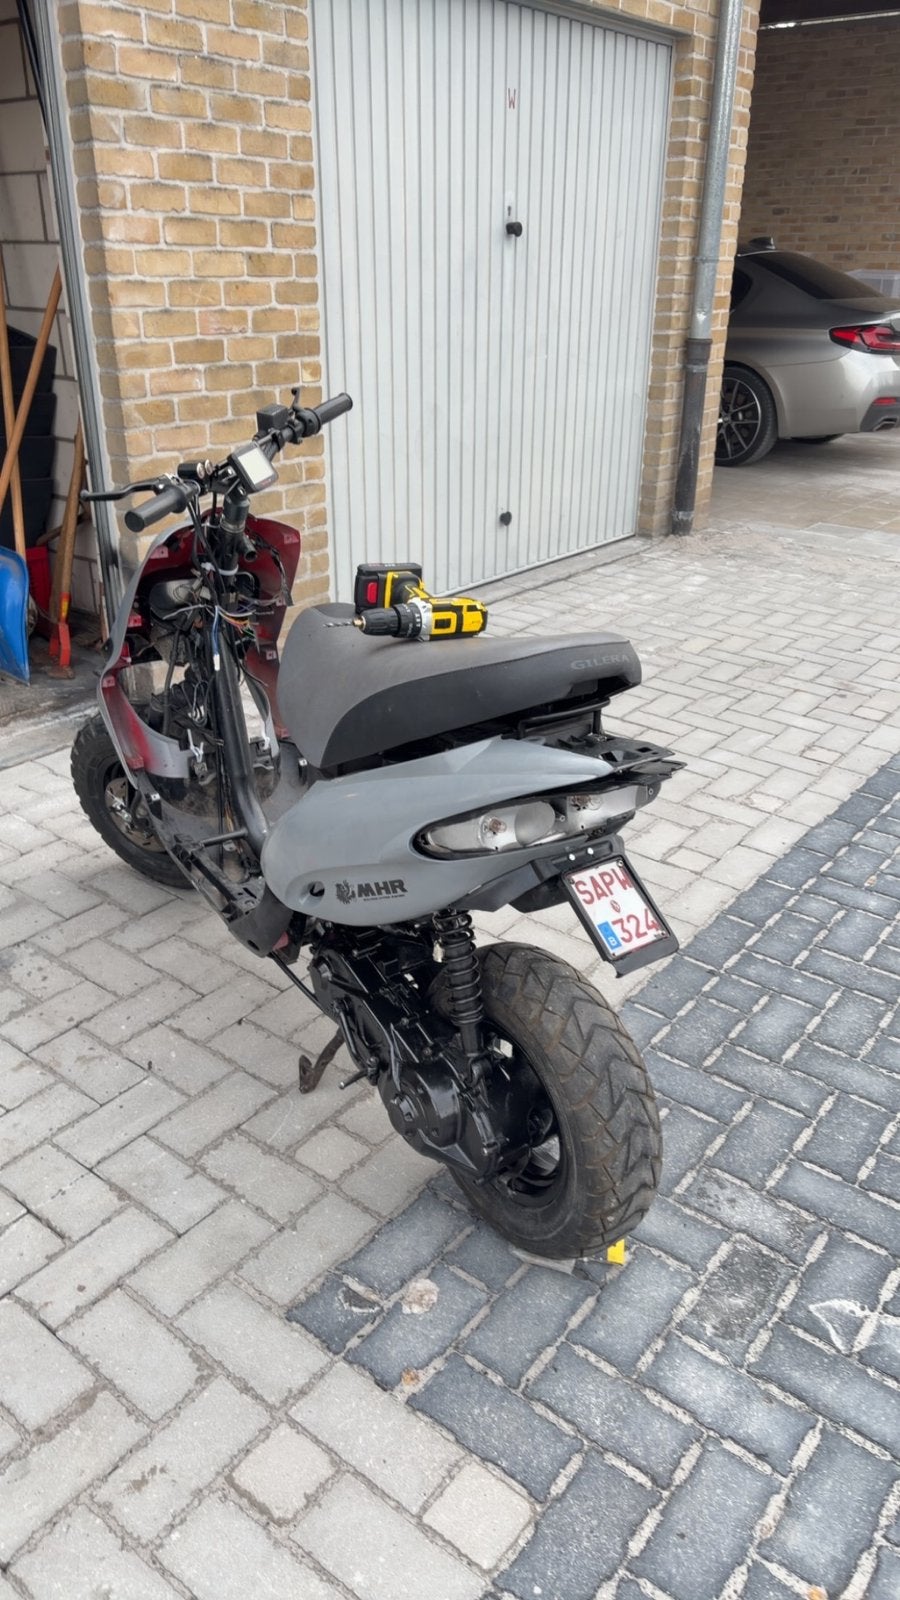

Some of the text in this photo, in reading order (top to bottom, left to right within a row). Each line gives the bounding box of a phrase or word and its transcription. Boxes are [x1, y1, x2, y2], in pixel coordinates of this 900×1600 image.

[507, 87, 516, 110] W
[570, 654, 630, 670] GILERA
[357, 879, 408, 898] MHR
[574, 866, 633, 905] SAPW
[608, 908, 659, 946] B 324
